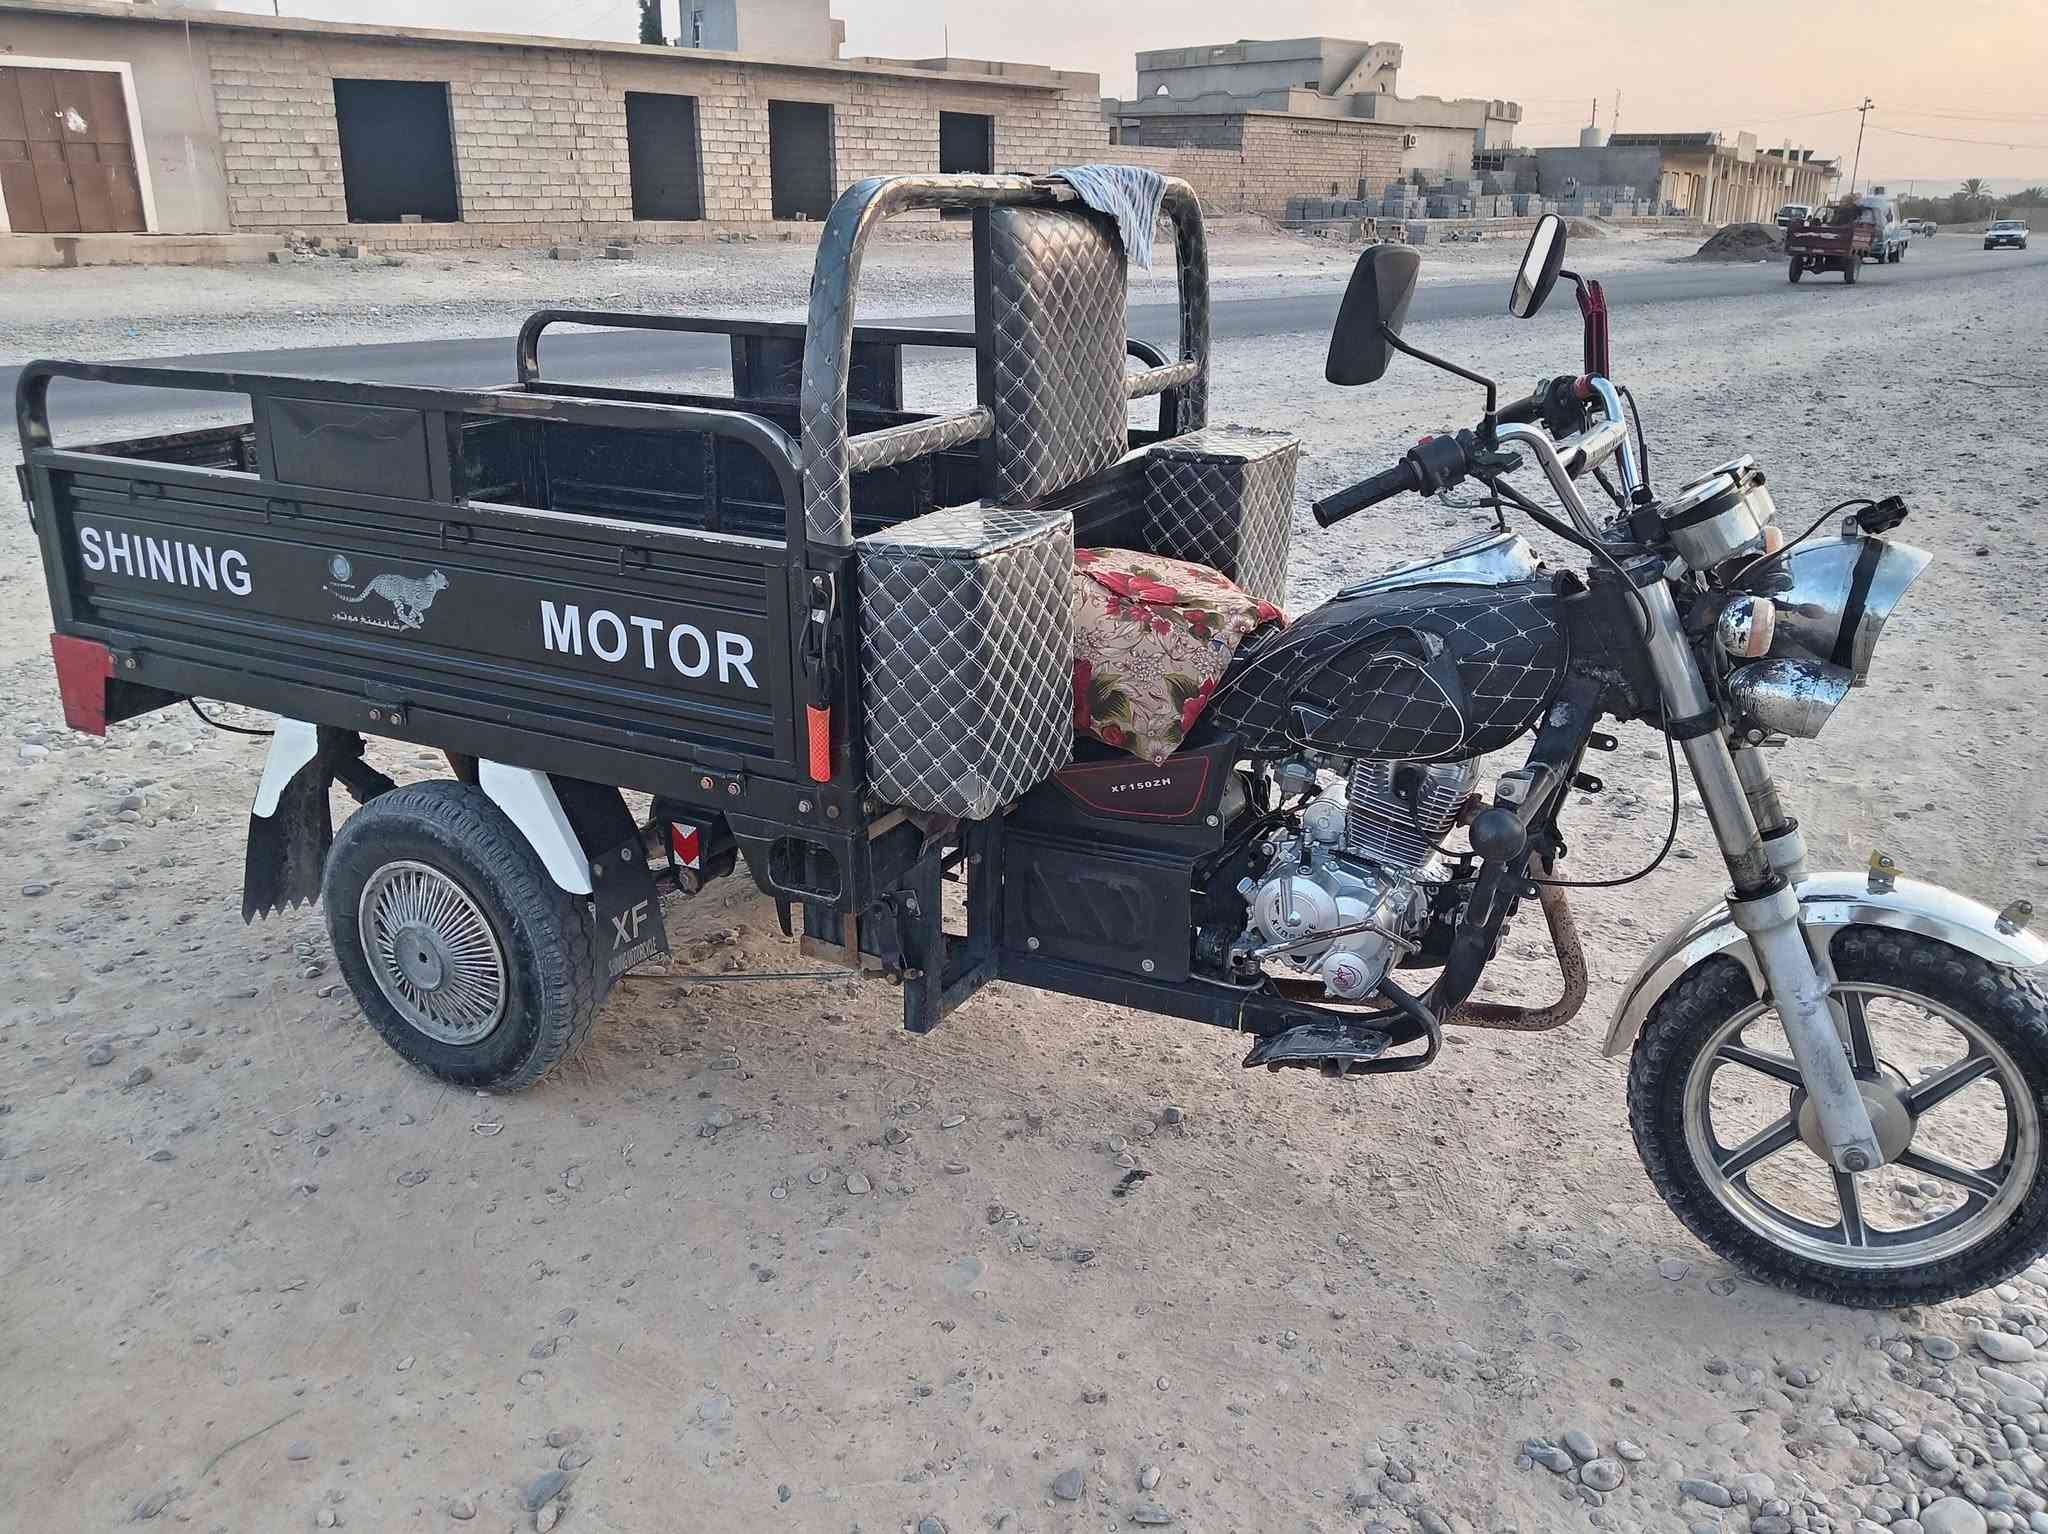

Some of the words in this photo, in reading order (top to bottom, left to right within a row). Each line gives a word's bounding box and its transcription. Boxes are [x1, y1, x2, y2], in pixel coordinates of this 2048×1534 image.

[80, 527, 252, 595] SHINING
[541, 600, 759, 689] MOTOR
[1111, 777, 1172, 793] XF150ZH
[612, 899, 648, 951] XF
